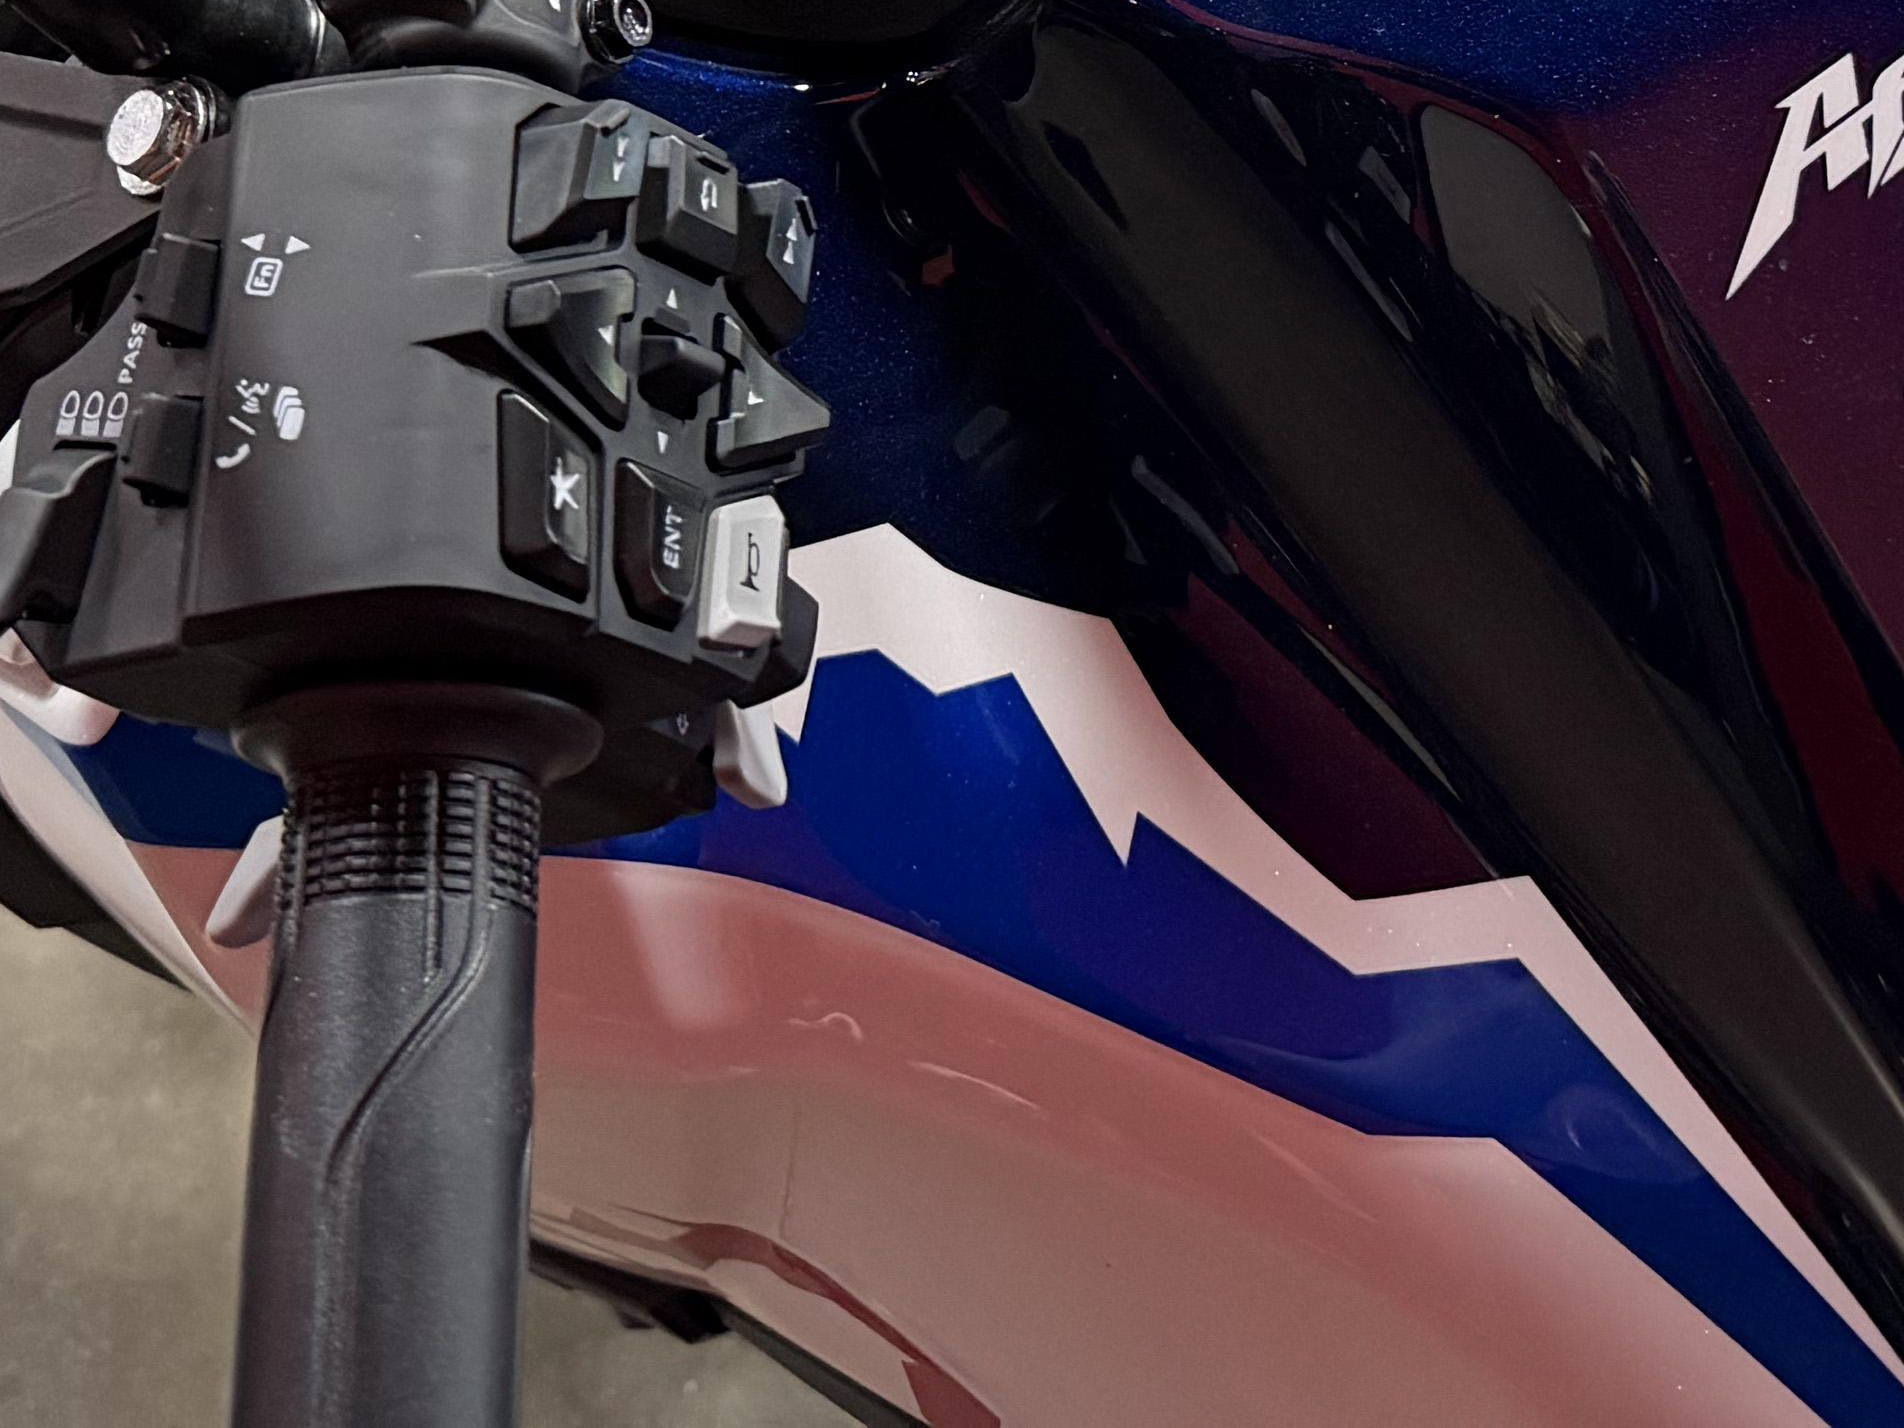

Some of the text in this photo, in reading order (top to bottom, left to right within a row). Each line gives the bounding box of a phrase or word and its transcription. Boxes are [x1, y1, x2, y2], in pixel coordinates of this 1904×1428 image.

[252, 263, 275, 288] Fn
[116, 321, 148, 384] PASS
[661, 504, 684, 570] ENT
